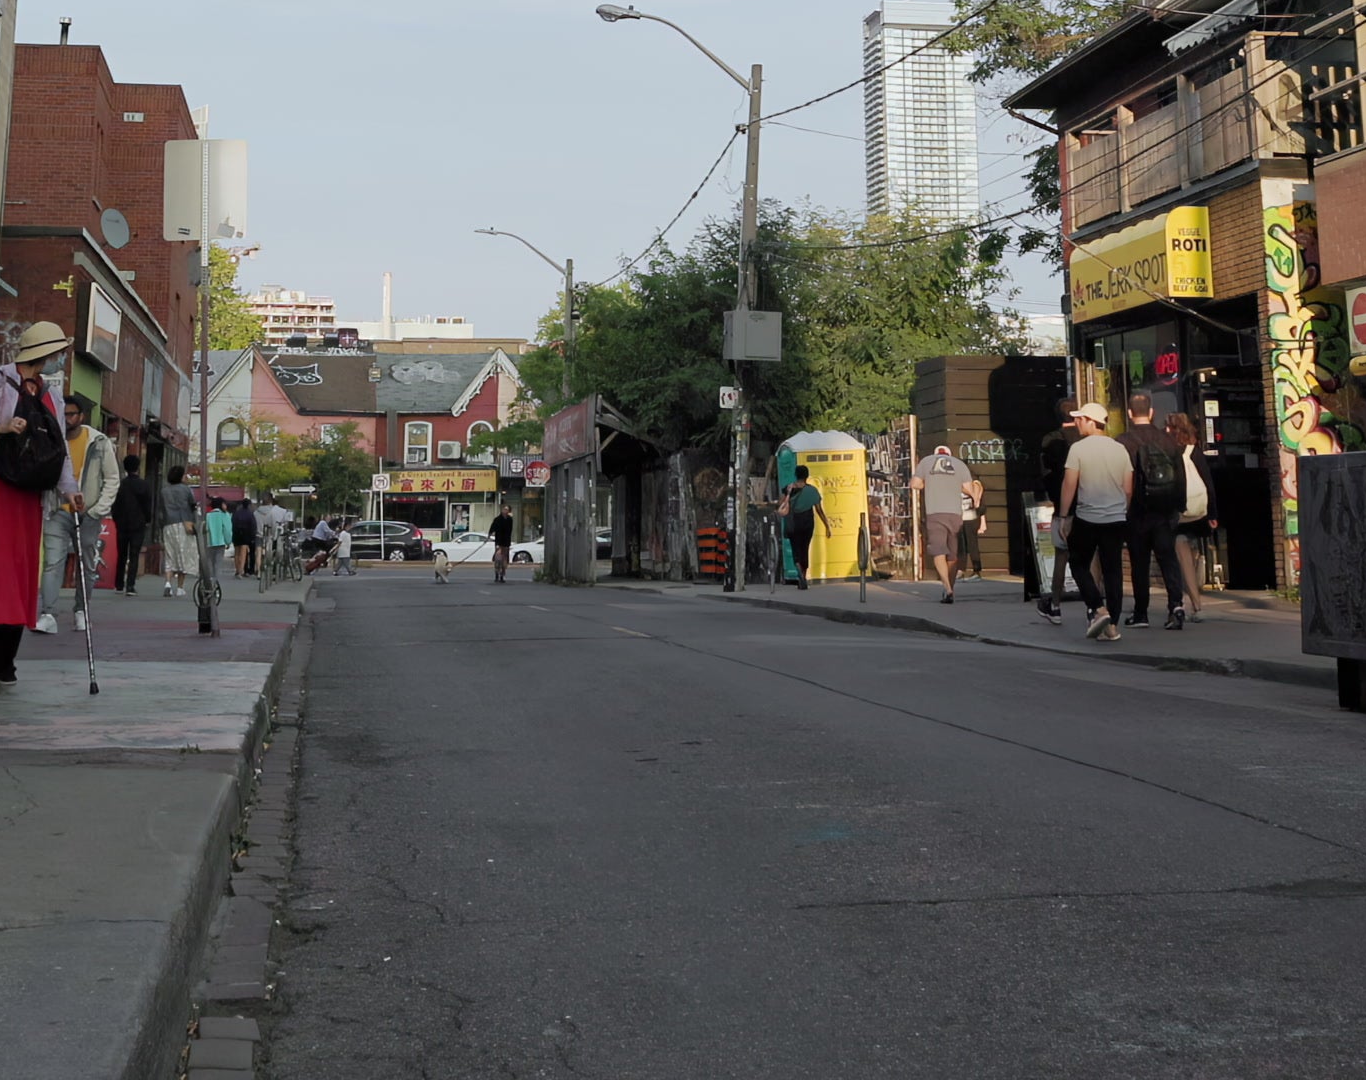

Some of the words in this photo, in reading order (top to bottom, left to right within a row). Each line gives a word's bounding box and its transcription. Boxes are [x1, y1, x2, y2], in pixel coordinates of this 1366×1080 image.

[1172, 238, 1207, 252] ROTI
[1086, 280, 1103, 301] THE
[1104, 264, 1133, 300] JERK
[1134, 253, 1166, 286] SPOT
[1175, 277, 1205, 285] CHICKEN
